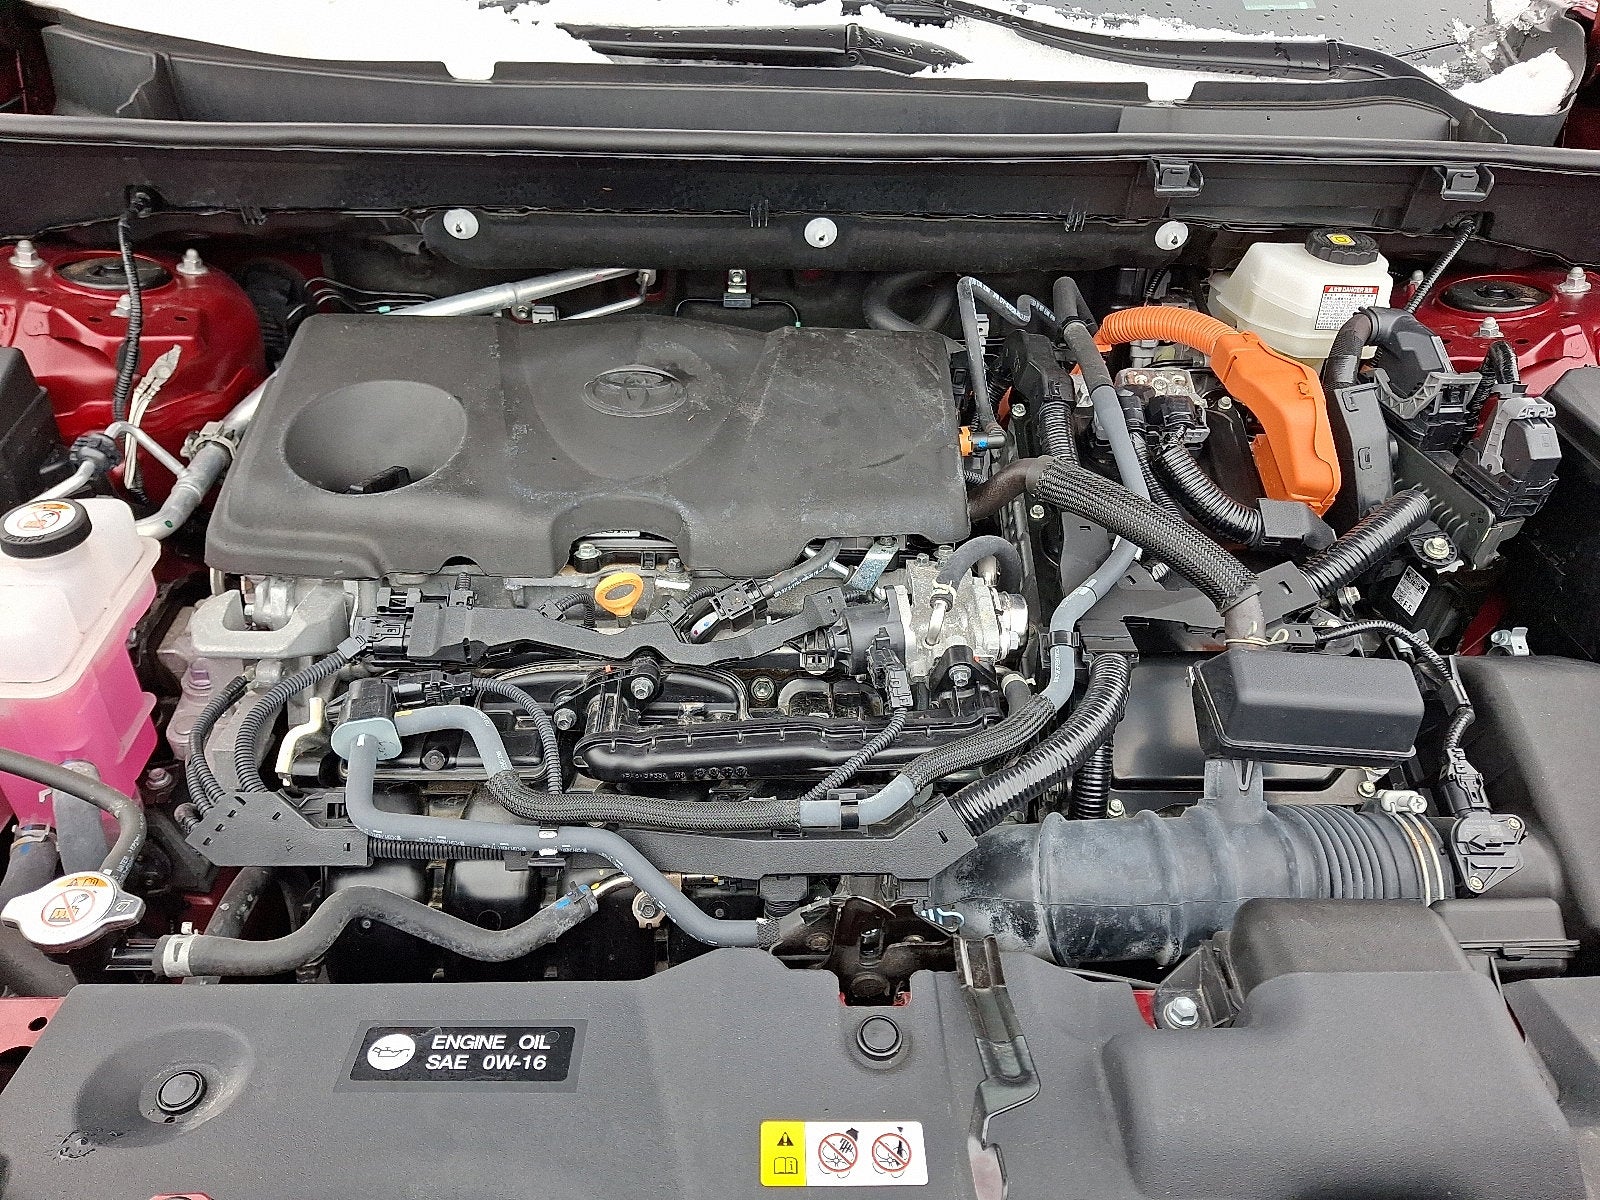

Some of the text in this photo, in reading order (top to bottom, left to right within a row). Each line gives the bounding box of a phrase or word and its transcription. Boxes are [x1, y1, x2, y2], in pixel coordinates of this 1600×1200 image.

[431, 1034, 551, 1050] ENGINE OIL
[425, 1055, 547, 1070] SAE 0W-16
